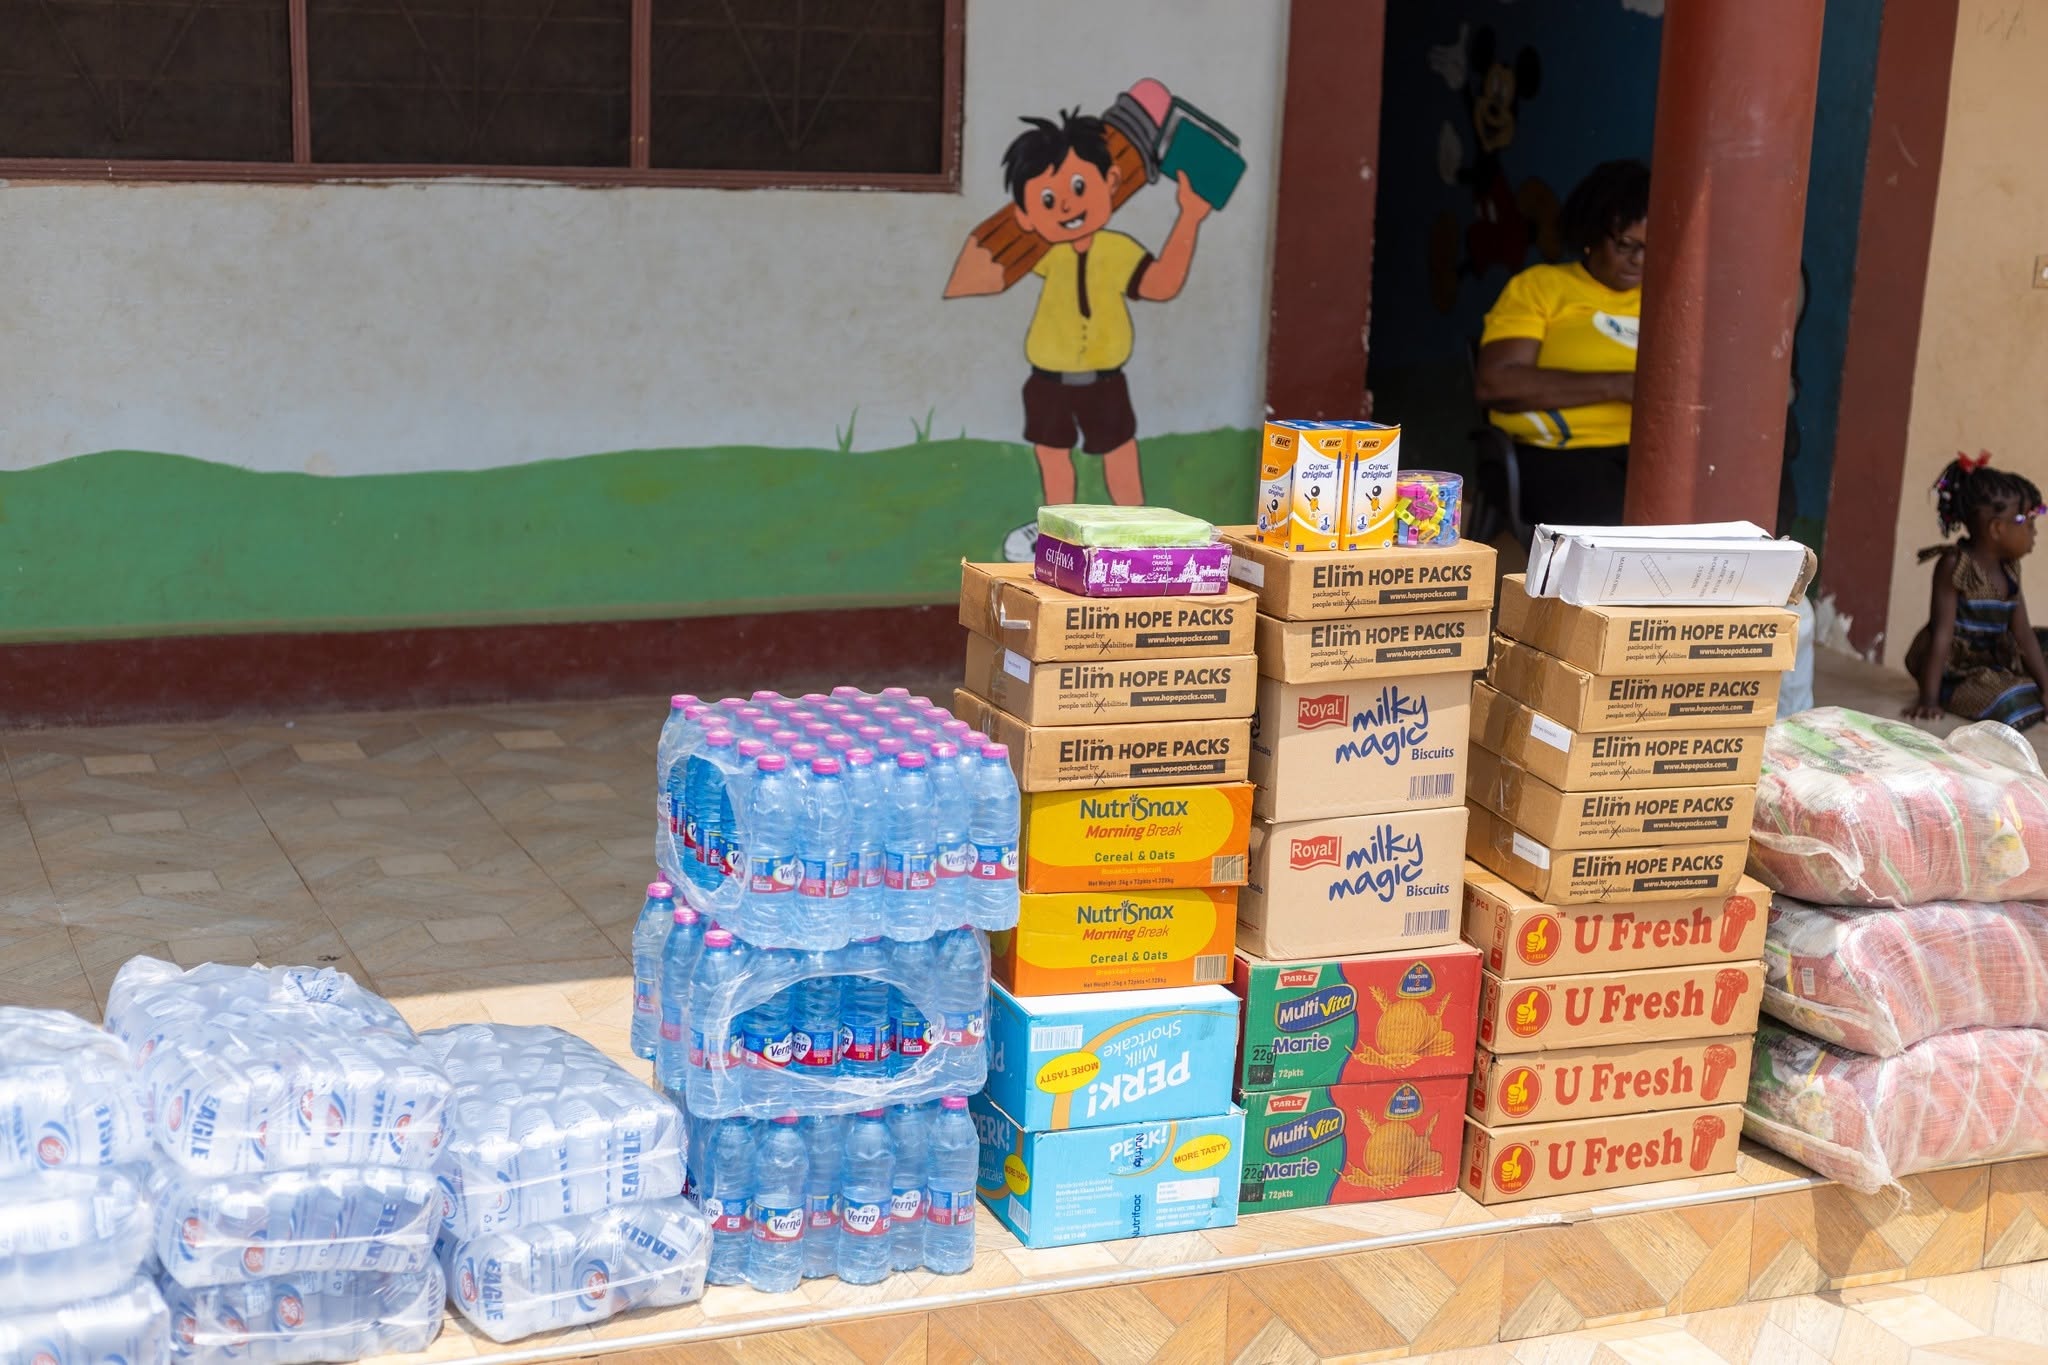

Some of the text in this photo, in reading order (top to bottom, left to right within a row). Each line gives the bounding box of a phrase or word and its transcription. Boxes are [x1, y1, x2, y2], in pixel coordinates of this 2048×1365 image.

[1302, 471, 1333, 480] Original
[1362, 471, 1391, 480] Original
[1046, 548, 1073, 571] GUHWA
[1313, 565, 1472, 588] Elim HOPE PACKS
[1312, 600, 1330, 609] people
[1066, 607, 1233, 629] Elim HOPE PACKS
[1311, 622, 1465, 648] Elim HOPE PACKS
[1629, 620, 1778, 641] Elim HOPE PACKS
[1065, 642, 1084, 650] people
[1311, 660, 1329, 668] people
[1331, 658, 1343, 666] with
[1059, 667, 1231, 689] Elim HOPE PACKS
[1609, 679, 1760, 700] Elim HOPE PACKS
[1059, 702, 1078, 710] people
[1300, 700, 1340, 719] Royal
[1352, 685, 1428, 732] milky
[1060, 738, 1229, 762] Elim HOPE PACKS
[1336, 726, 1428, 765] magic
[1412, 747, 1454, 760] Biscuits
[1593, 736, 1743, 758] Elim HOPE PACKS
[1080, 794, 1188, 821] NutriSnax
[1582, 796, 1734, 817] Elim HOPE PACKS
[1086, 822, 1183, 840] Morning Break
[1095, 850, 1175, 862] Cereal & Oats
[1292, 842, 1332, 859] Royal
[1347, 825, 1423, 870] milky
[1572, 855, 1723, 877] Elim HOPE PACKS
[1329, 864, 1422, 902] magic
[1407, 884, 1449, 897] Biscuits
[1078, 901, 1174, 924] NutriSnax
[1083, 925, 1169, 942] Morning Break
[1574, 907, 1712, 954] U Fresh
[1090, 951, 1168, 964] Cereal & Oats
[1283, 974, 1315, 983] PARLE
[1280, 994, 1351, 1025] Multi Vita
[1565, 980, 1704, 1026] U Fresh
[1103, 1019, 1182, 1057] Shortcake
[1274, 1033, 1330, 1054] Marie
[1125, 1044, 1157, 1069] Milk
[1252, 1049, 1273, 1064] 22g
[1040, 1061, 1098, 1084] MORE TASTY
[1279, 1069, 1304, 1079] 72pkts
[1555, 1057, 1693, 1105] U Fresh
[1086, 1051, 1190, 1119] PERK!
[1273, 1100, 1303, 1109] PARLE
[192, 1094, 220, 1160] EAGLE
[1269, 1117, 1339, 1149] Multi Vita
[1174, 1142, 1227, 1164] MORE TASTY
[1548, 1128, 1682, 1180] U Fresh
[1244, 1168, 1264, 1182] 22g
[1264, 1157, 1318, 1179] Marie
[774, 1218, 800, 1230] Verna
[847, 1210, 875, 1225] Verna
